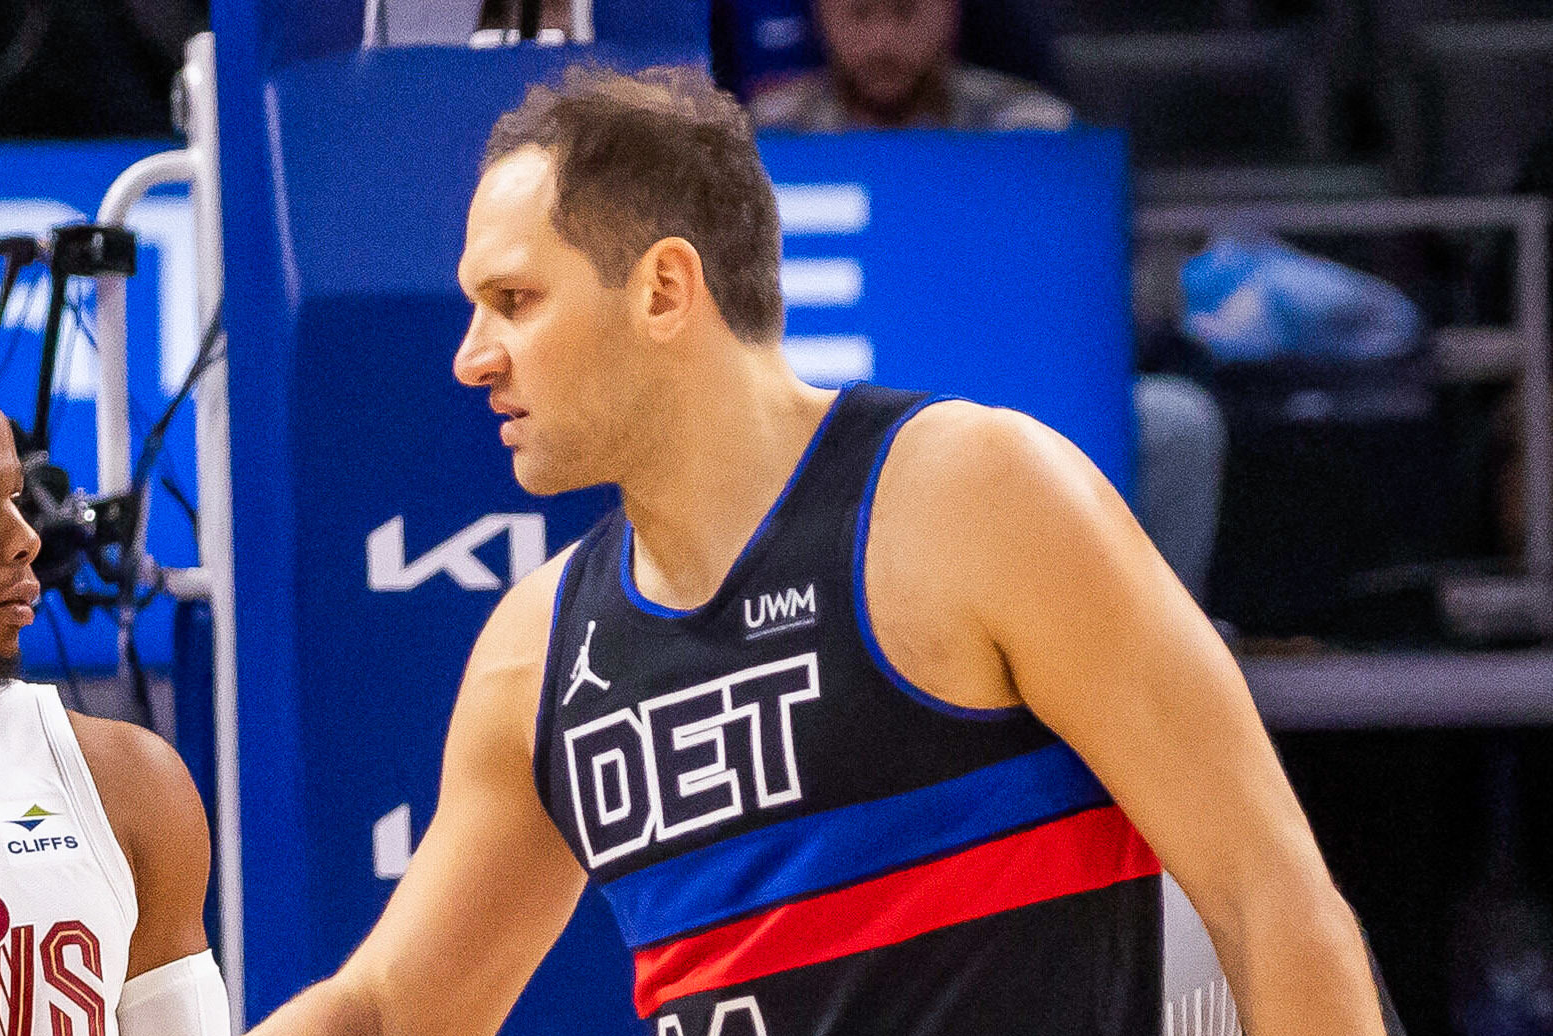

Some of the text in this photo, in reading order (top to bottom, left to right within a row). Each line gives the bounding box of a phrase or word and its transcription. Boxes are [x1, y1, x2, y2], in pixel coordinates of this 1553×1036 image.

[367, 513, 545, 592] KI
[745, 583, 816, 628] UWM
[563, 652, 821, 869] DET
[7, 835, 79, 855] CLIFFS
